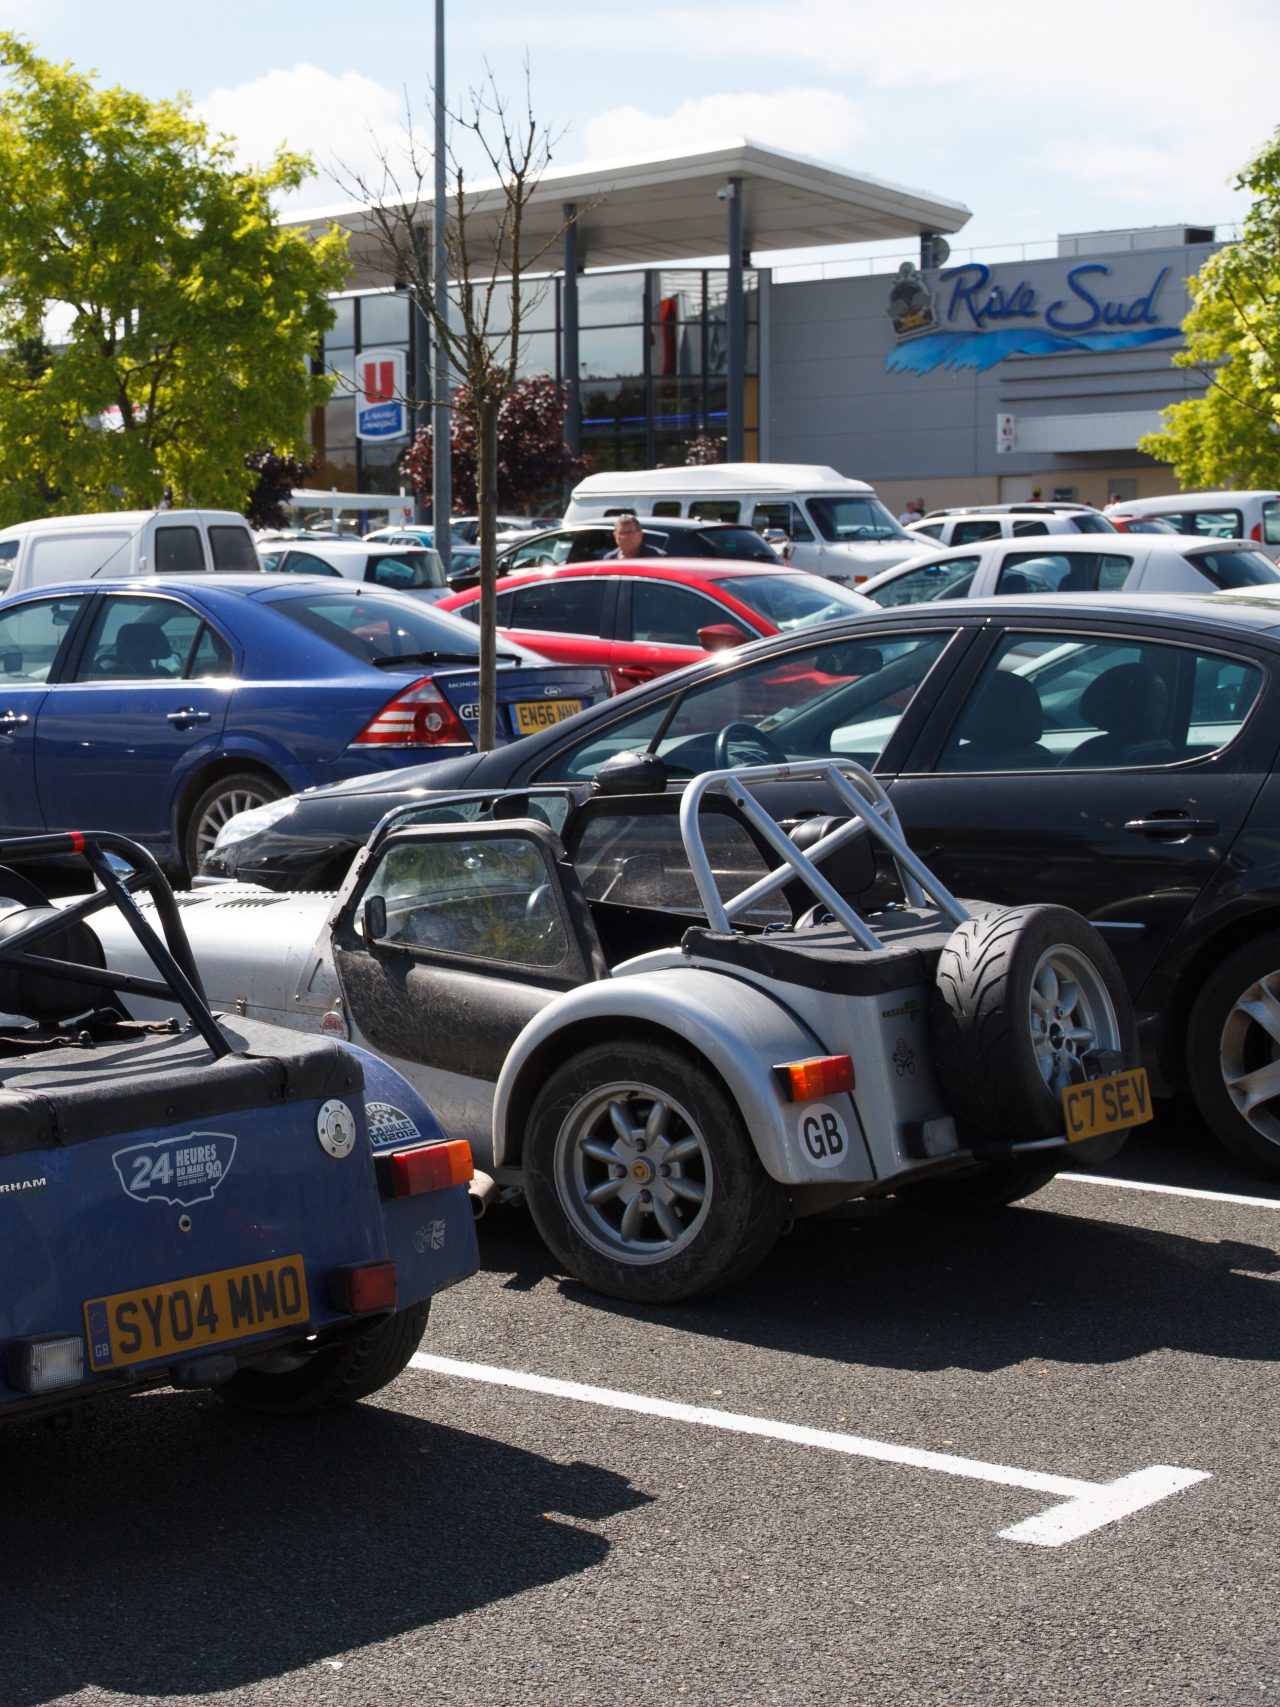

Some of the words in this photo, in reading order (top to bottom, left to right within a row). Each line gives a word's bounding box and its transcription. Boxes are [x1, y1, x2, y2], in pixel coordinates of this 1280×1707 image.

[939, 263, 1038, 328] Rive
[1045, 263, 1170, 331] Sud
[364, 361, 394, 404] U
[520, 704, 556, 727] EN56
[1067, 1088, 1095, 1133] C7
[1102, 1074, 1146, 1122] SEV
[382, 1120, 413, 1134] JUILLET
[386, 1128, 418, 1141] 2012
[803, 1112, 843, 1160] GB
[176, 1144, 217, 1167] HEURES
[130, 1152, 173, 1191] 24
[176, 1166, 186, 1177] DU
[186, 1163, 205, 1175] MANS
[205, 1160, 222, 1179] 90
[115, 1283, 218, 1354] SY04
[227, 1266, 302, 1328] MMO
[95, 1342, 109, 1358] GB
